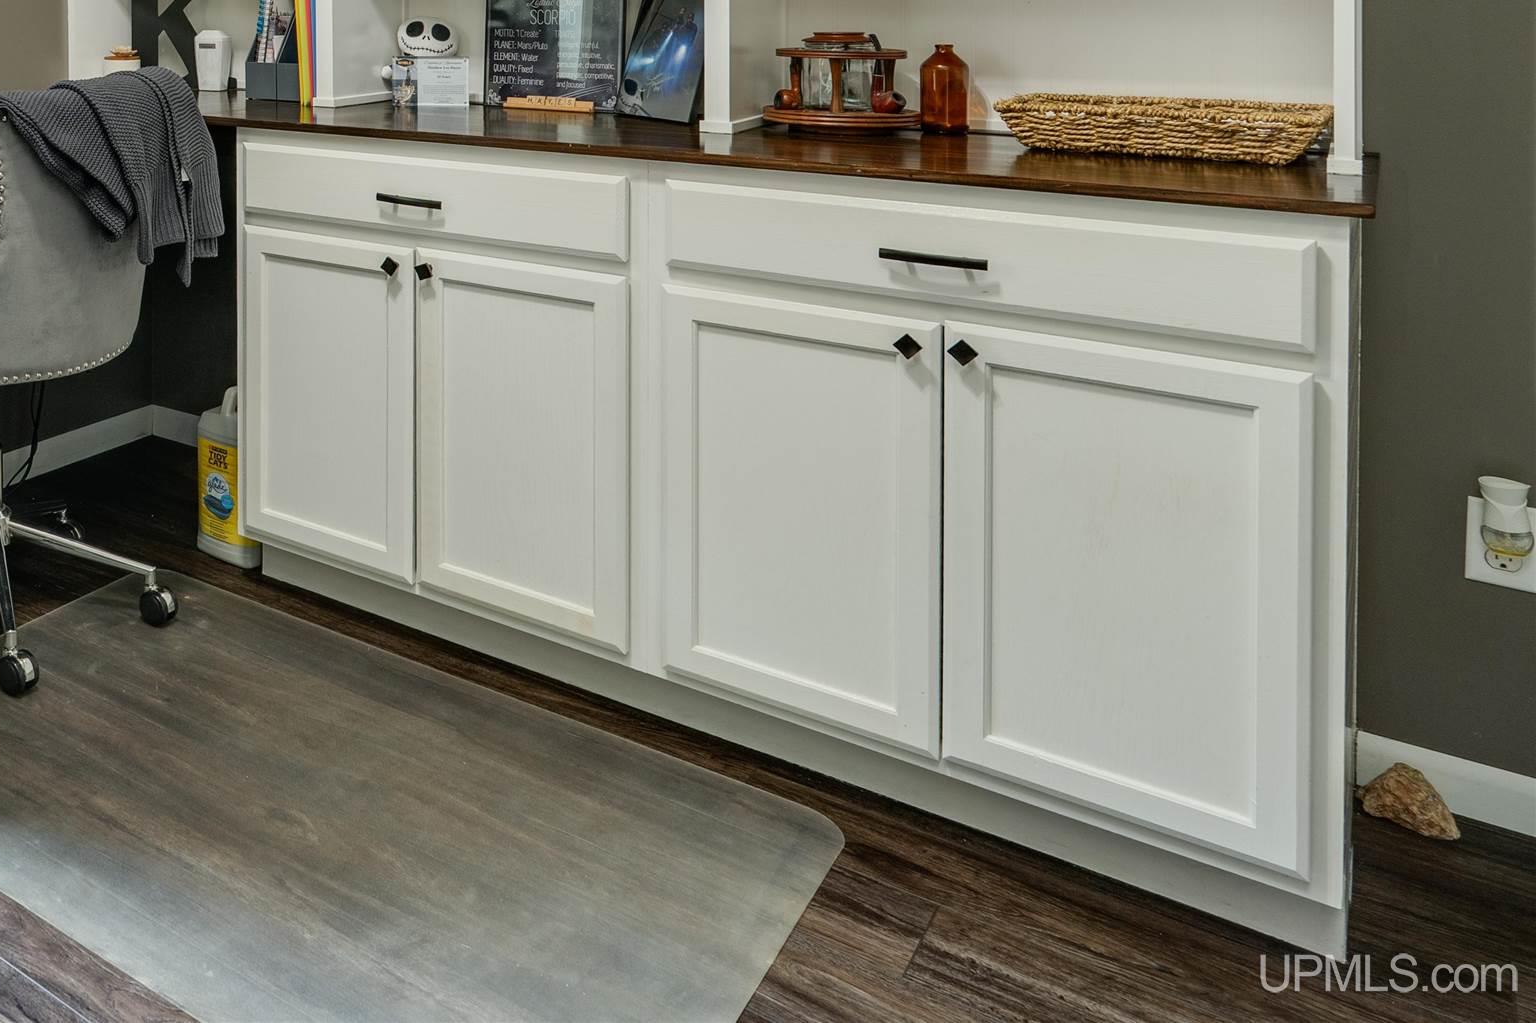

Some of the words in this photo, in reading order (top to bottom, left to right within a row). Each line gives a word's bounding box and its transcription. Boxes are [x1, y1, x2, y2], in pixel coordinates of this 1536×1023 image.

[530, 9, 576, 25] SCORPIO
[494, 41, 517, 49] PLANET:
[518, 42, 548, 50] Mars/Pluto
[494, 53, 520, 61] ELEMENT:
[521, 54, 539, 62] Water
[209, 451, 227, 461] TIDY
[208, 458, 228, 469] CATS
